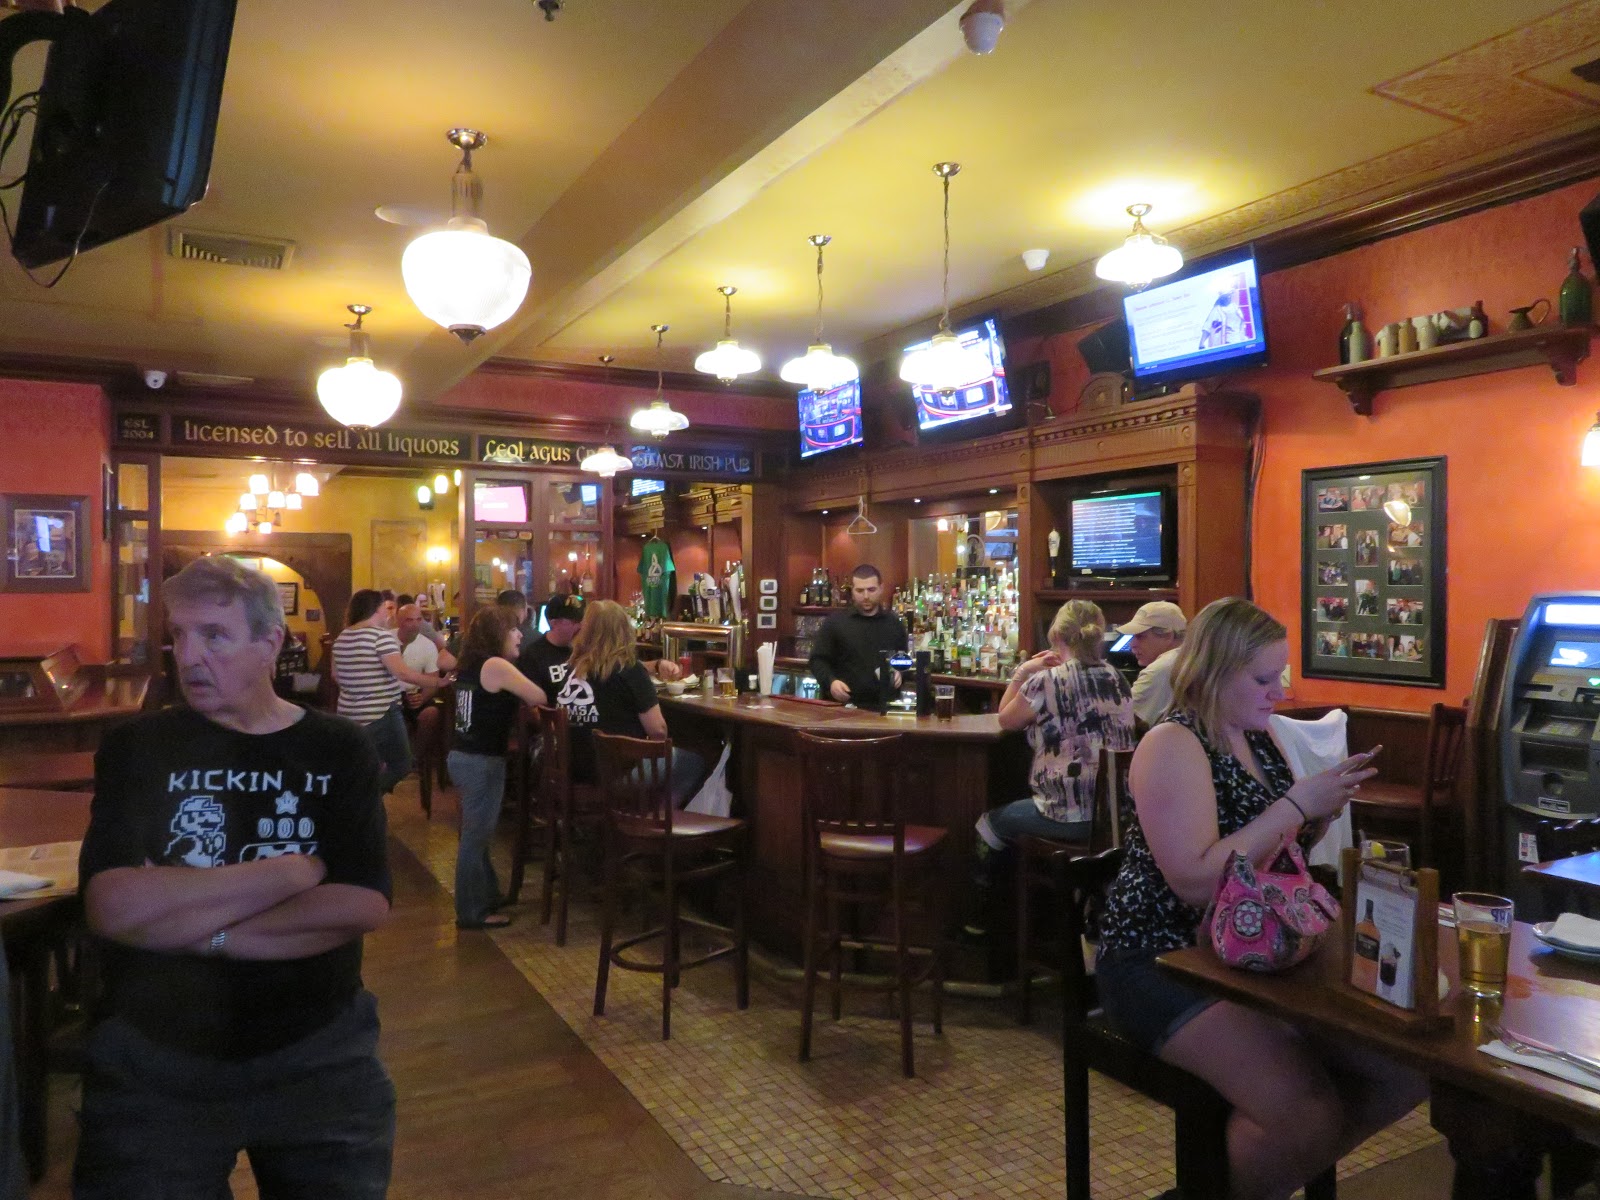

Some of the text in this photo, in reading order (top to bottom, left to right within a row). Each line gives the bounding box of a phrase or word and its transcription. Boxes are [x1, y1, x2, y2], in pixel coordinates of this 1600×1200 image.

[283, 427, 308, 447] to
[314, 430, 351, 449] sell
[357, 431, 382, 451] all
[387, 432, 460, 458] liquors
[529, 444, 571, 465] agus
[689, 455, 720, 471] IRISH
[724, 457, 750, 473] PUB
[168, 769, 332, 796] KICKIN IT
